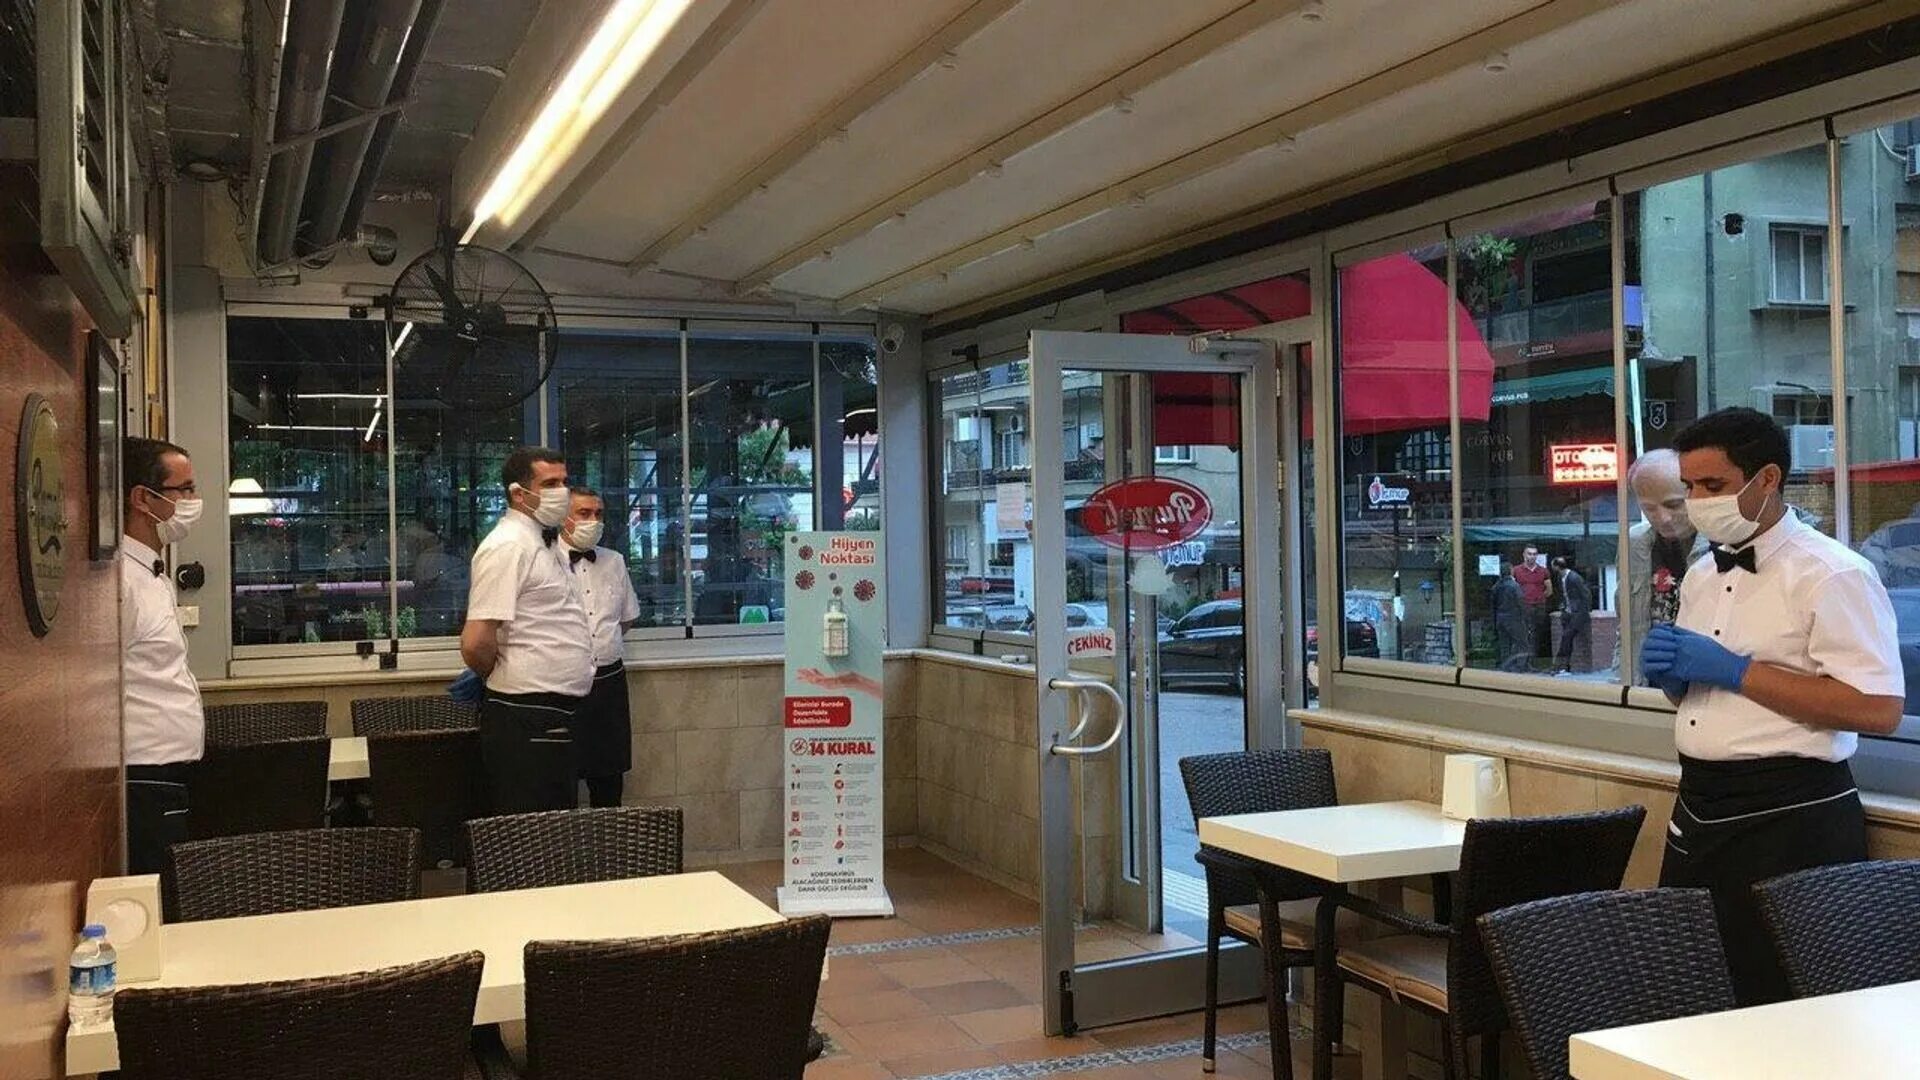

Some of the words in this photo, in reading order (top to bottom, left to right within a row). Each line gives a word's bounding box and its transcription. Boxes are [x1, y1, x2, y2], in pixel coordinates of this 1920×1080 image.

[831, 536, 875, 554] Hijyen
[819, 552, 875, 565] Noktası
[810, 742, 825, 756] 14
[828, 742, 876, 756] KURAL
